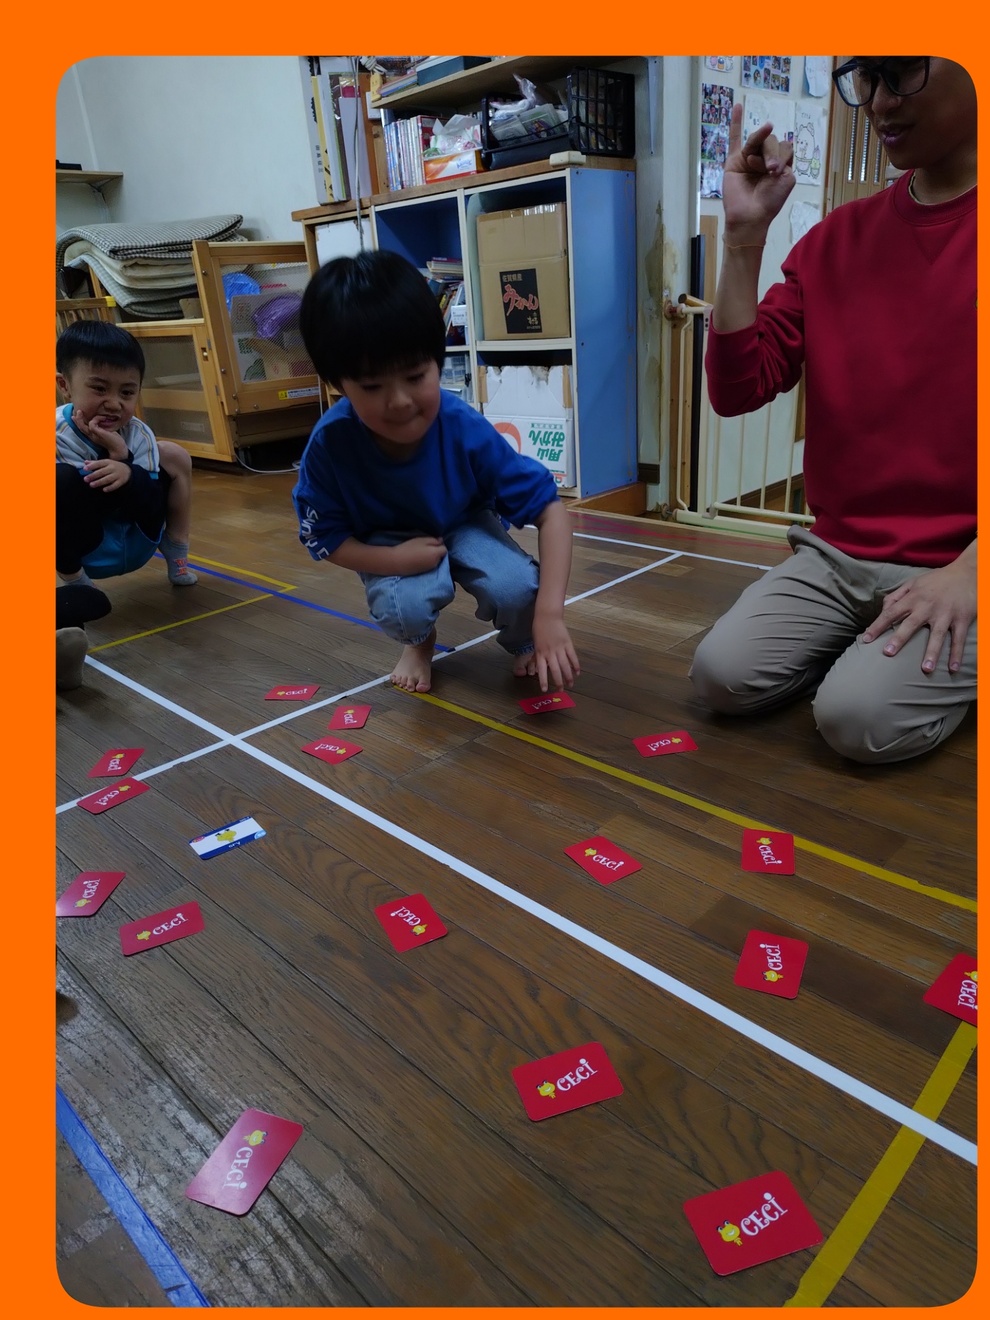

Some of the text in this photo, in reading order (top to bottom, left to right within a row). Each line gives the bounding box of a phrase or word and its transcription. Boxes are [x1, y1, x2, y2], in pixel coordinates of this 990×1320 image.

[503, 284, 539, 316] みかん
[529, 430, 565, 447] みかん
